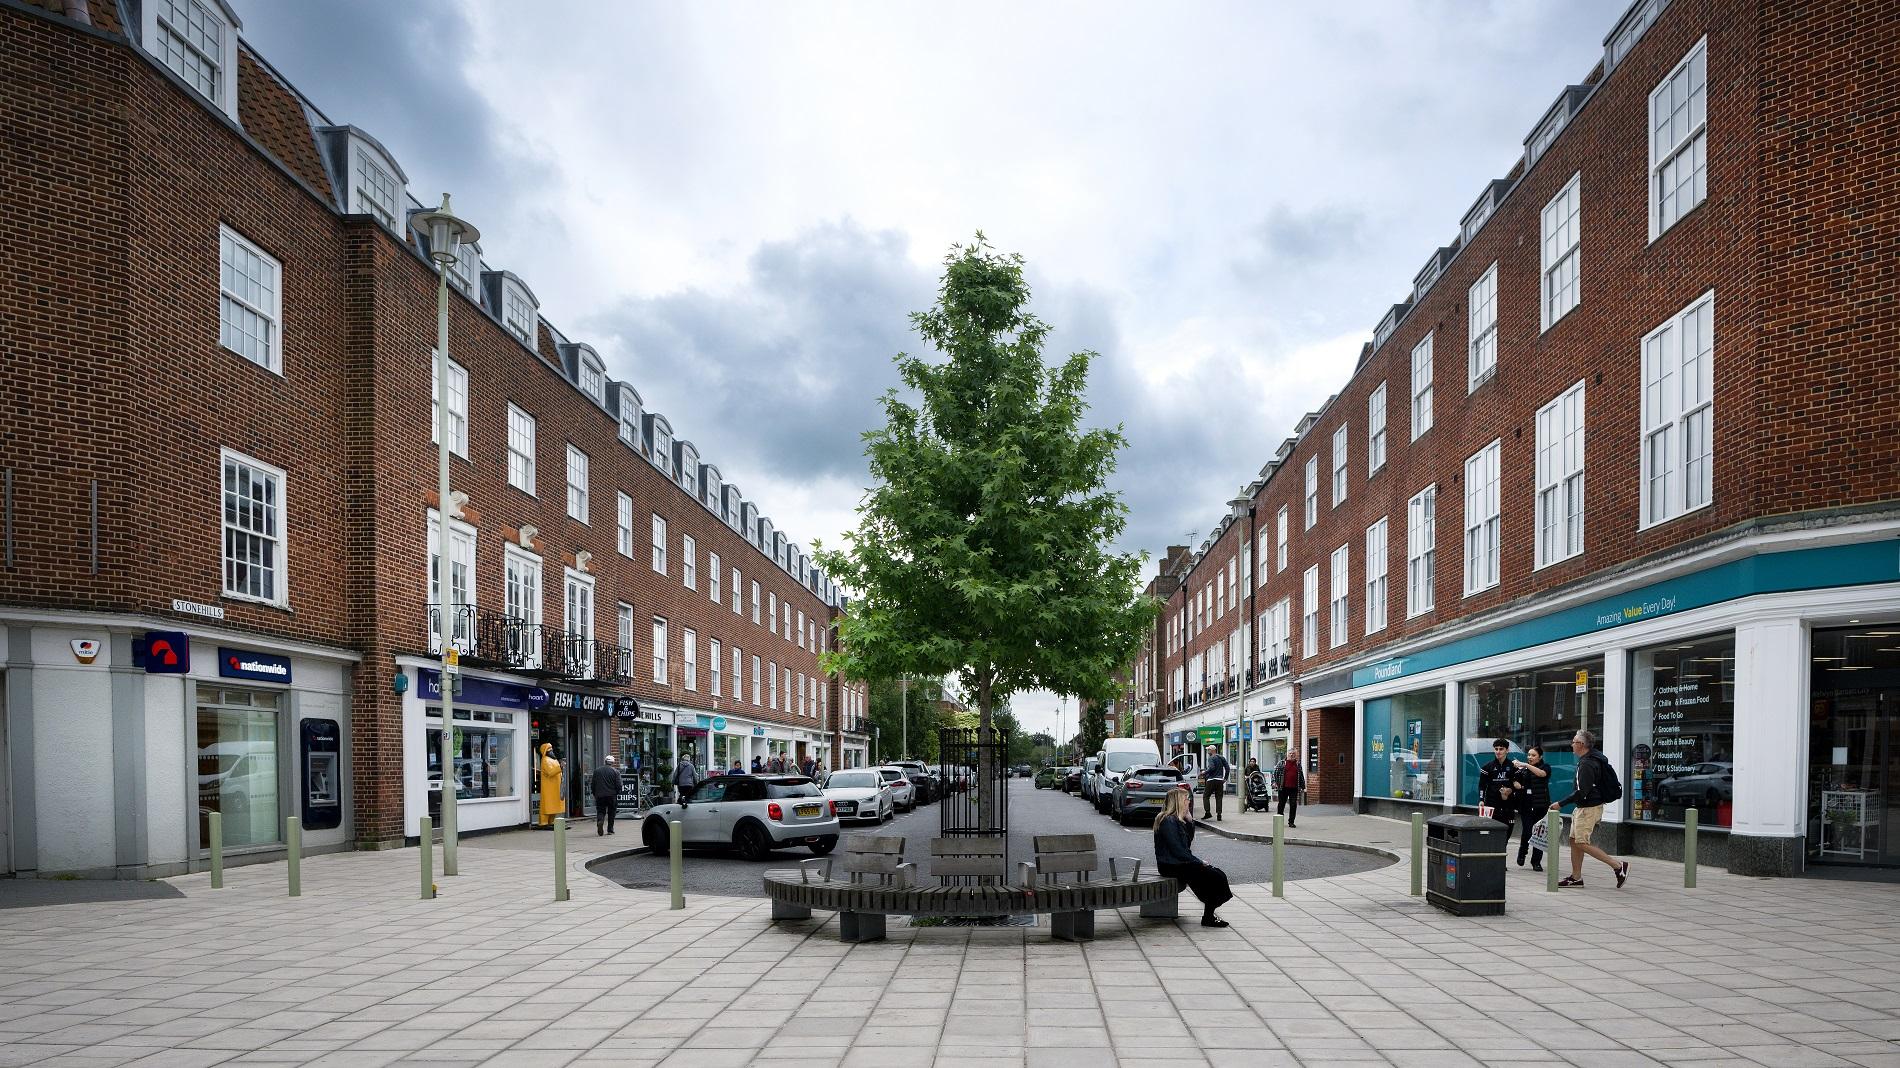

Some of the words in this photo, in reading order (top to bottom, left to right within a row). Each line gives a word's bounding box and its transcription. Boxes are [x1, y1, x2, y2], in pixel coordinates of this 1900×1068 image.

[176, 600, 222, 618] STONEHILLS
[1596, 611, 1621, 626] Amazing
[1623, 605, 1642, 618] Value
[1642, 602, 1661, 614] Every
[1661, 596, 1676, 610] Day!
[240, 660, 287, 675] nationwide
[1374, 663, 1402, 680] Poundland
[1658, 685, 1678, 694] Clothing
[1683, 684, 1699, 692] Home
[553, 692, 573, 708] FISH
[582, 695, 605, 711] CHIPS
[1675, 698, 1679, 706] &
[1696, 695, 1710, 703] Food
[645, 711, 662, 721] HILLS
[1678, 738, 1696, 747] Beauty
[1657, 751, 1683, 759] Household
[1657, 764, 1666, 772] DIY
[1670, 764, 1696, 773] Stationery
